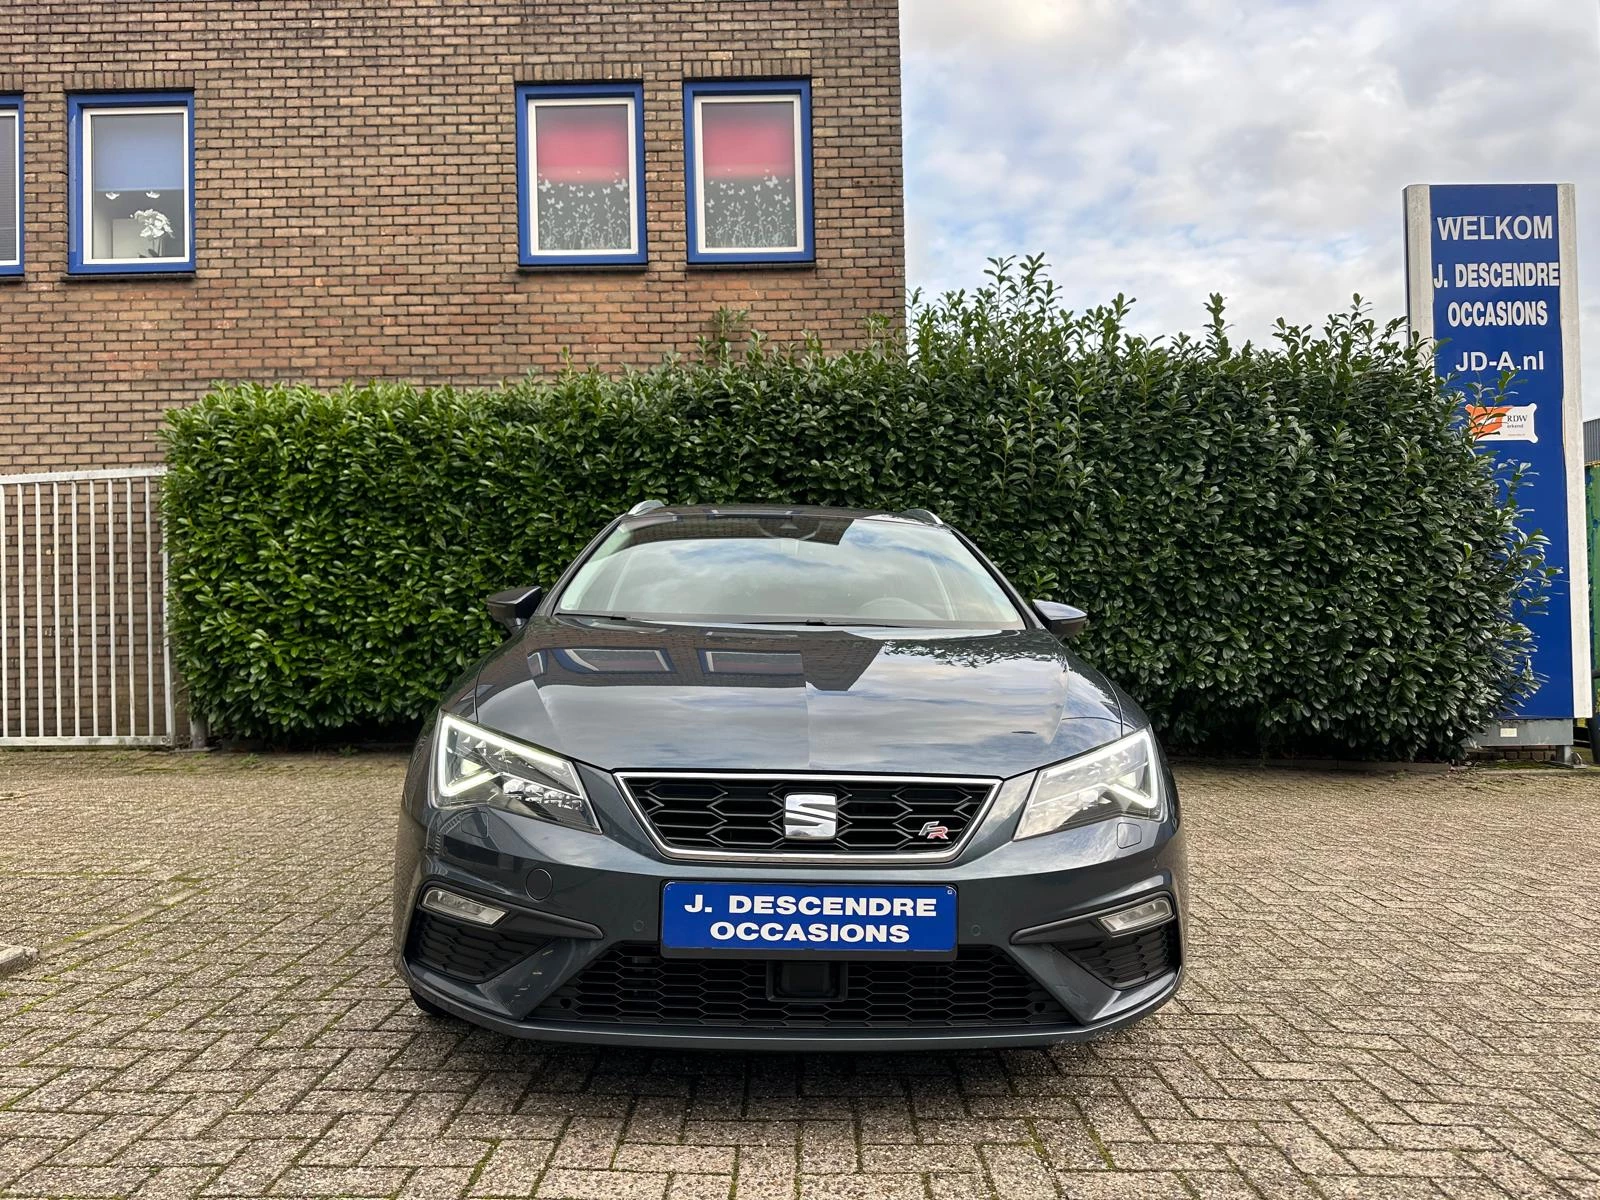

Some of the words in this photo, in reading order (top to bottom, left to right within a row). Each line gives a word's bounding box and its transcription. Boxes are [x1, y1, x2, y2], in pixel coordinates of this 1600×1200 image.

[1437, 215, 1553, 240] WELKOM
[1433, 264, 1448, 288] J.
[1455, 262, 1560, 288] DESCENDRE
[1448, 300, 1548, 327] OCCASIONS
[1455, 351, 1545, 371] JD-A.nl
[918, 820, 949, 839] FR
[684, 894, 713, 913] J.
[728, 895, 937, 917] DESCENDRE
[710, 921, 910, 943] OCCASIONS
